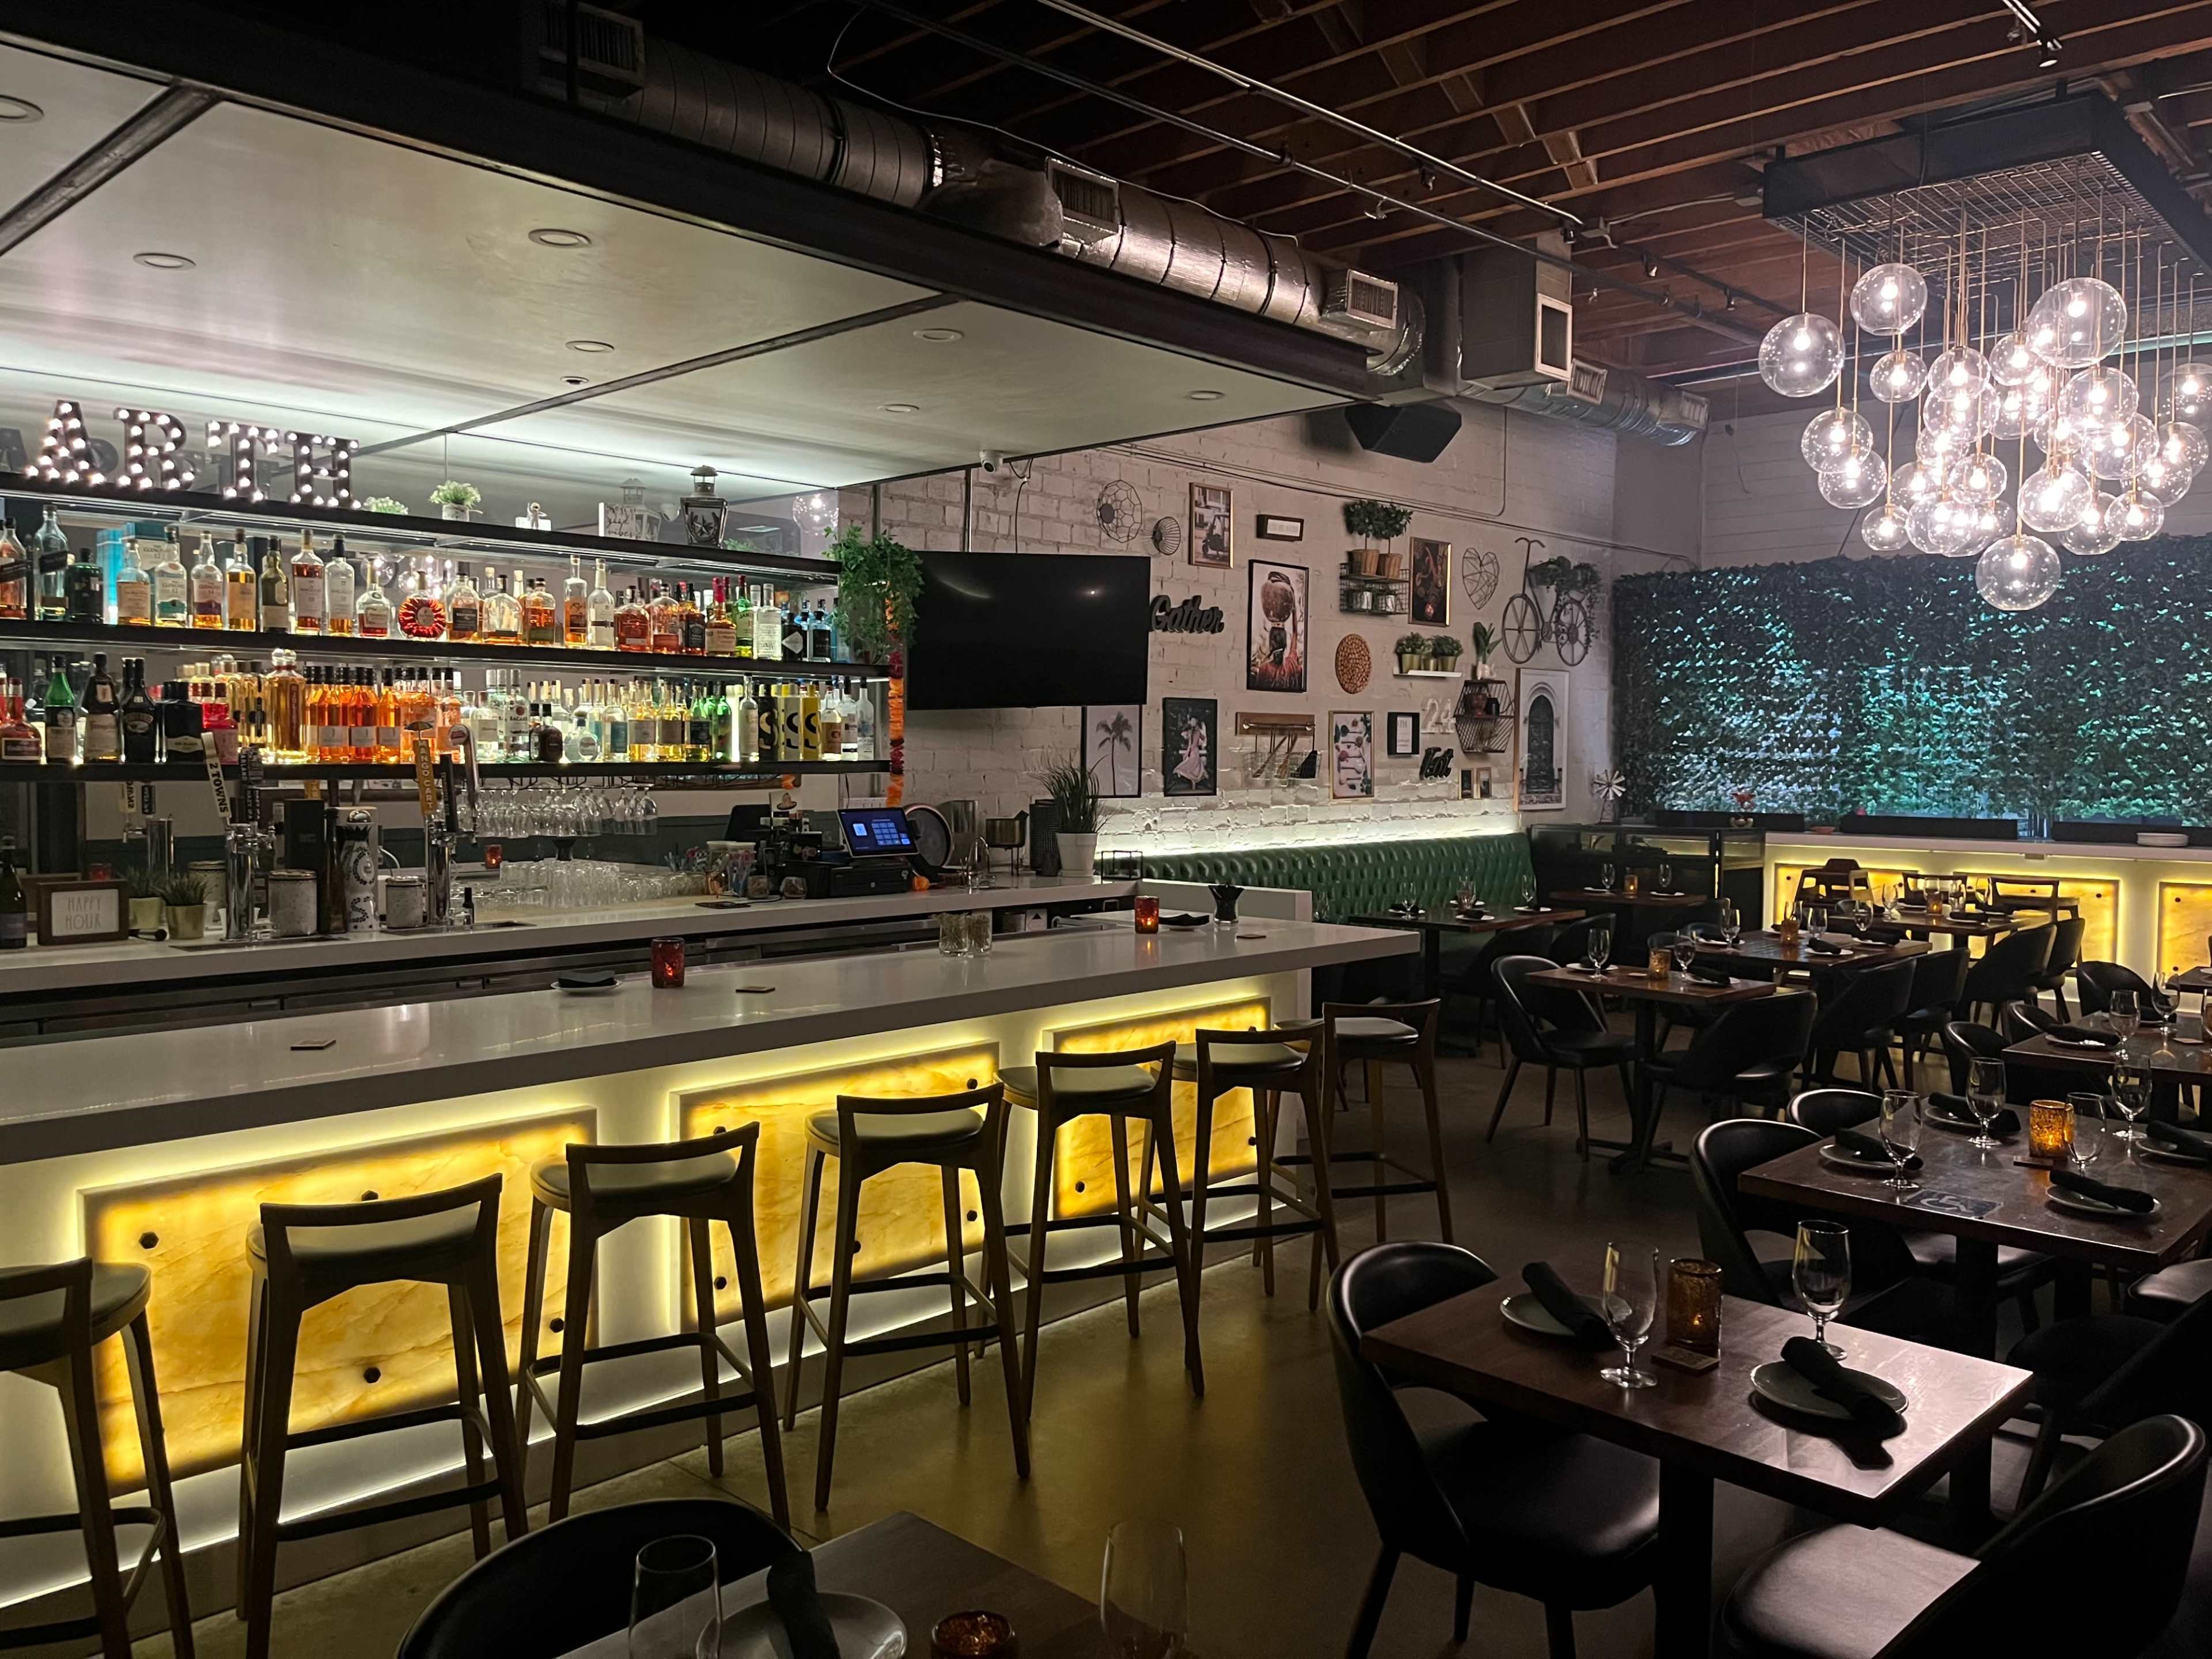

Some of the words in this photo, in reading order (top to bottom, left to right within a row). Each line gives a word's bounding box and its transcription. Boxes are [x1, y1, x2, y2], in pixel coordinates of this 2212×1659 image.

[25, 399, 362, 509] ARTH
[1150, 595, 1225, 634] Gather
[1420, 698, 1456, 734] 24
[418, 740, 430, 777] MANGO
[211, 770, 229, 813] TOWNS
[423, 780, 433, 809] CART
[67, 894, 101, 912] HAPPY
[65, 912, 102, 931] HOUR
